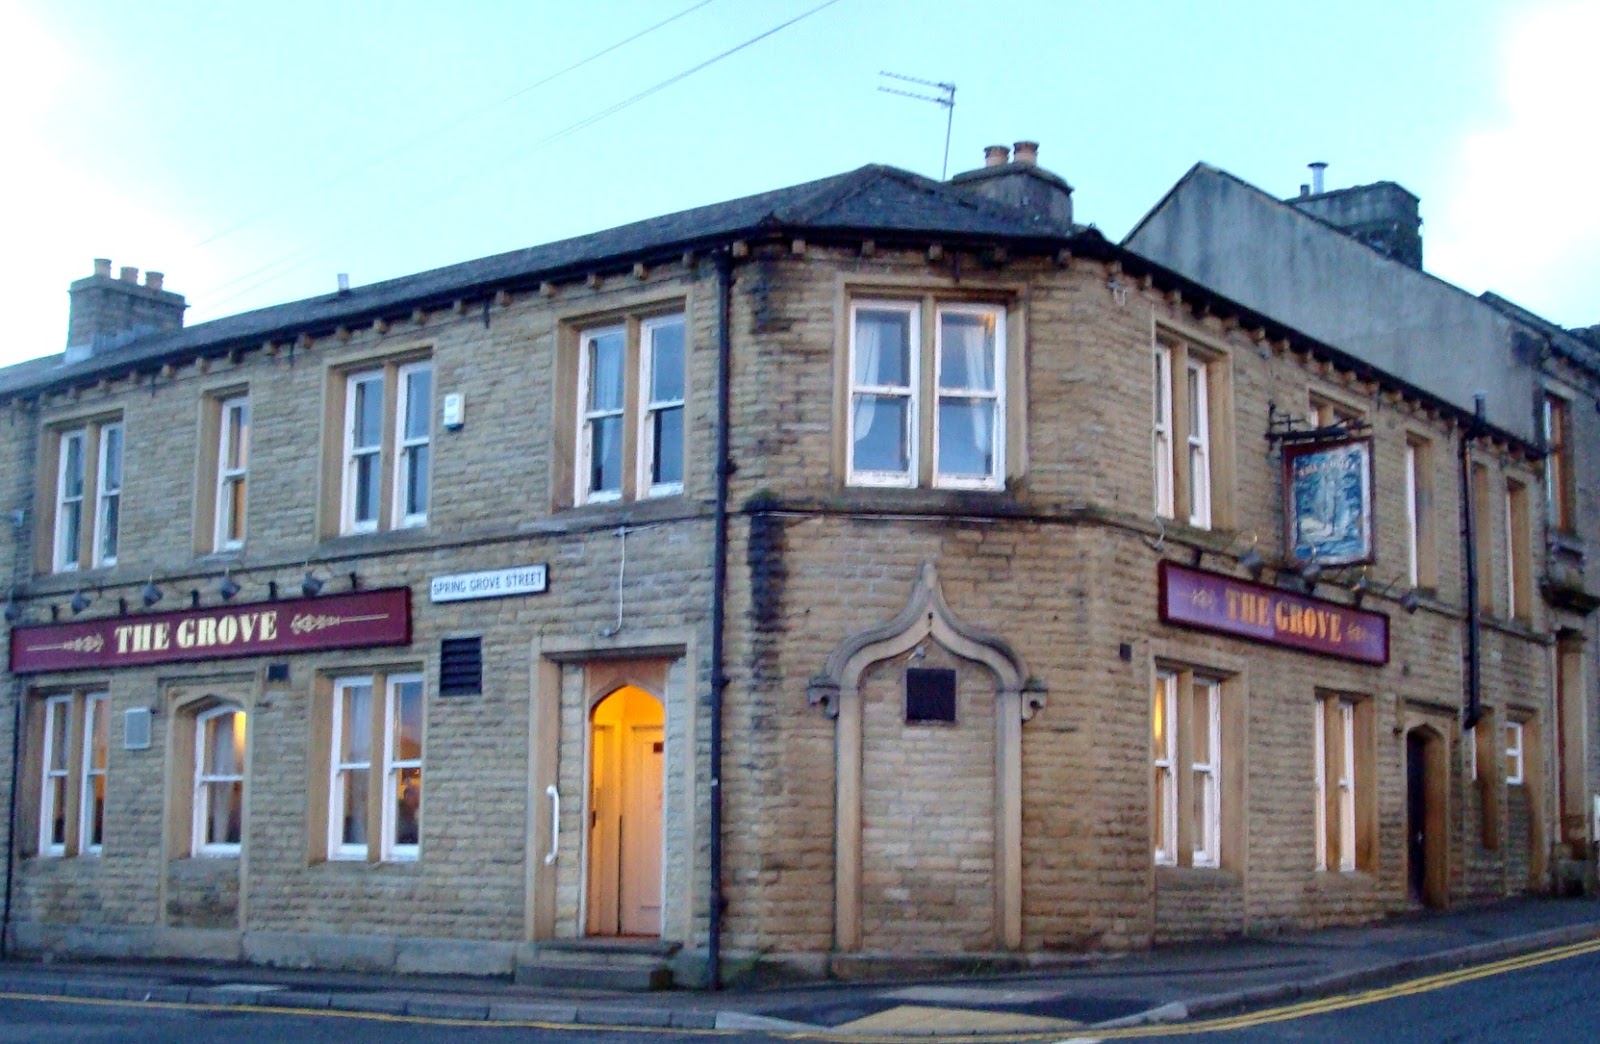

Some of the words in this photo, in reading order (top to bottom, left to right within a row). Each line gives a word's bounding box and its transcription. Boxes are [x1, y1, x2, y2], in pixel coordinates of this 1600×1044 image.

[433, 579, 467, 595] SPRING
[470, 575, 500, 592] GROVE
[506, 571, 542, 588] STREET
[115, 623, 170, 654] THE
[177, 611, 277, 648] GROVE
[1226, 589, 1270, 626] THE
[1275, 600, 1341, 642] GROVE
